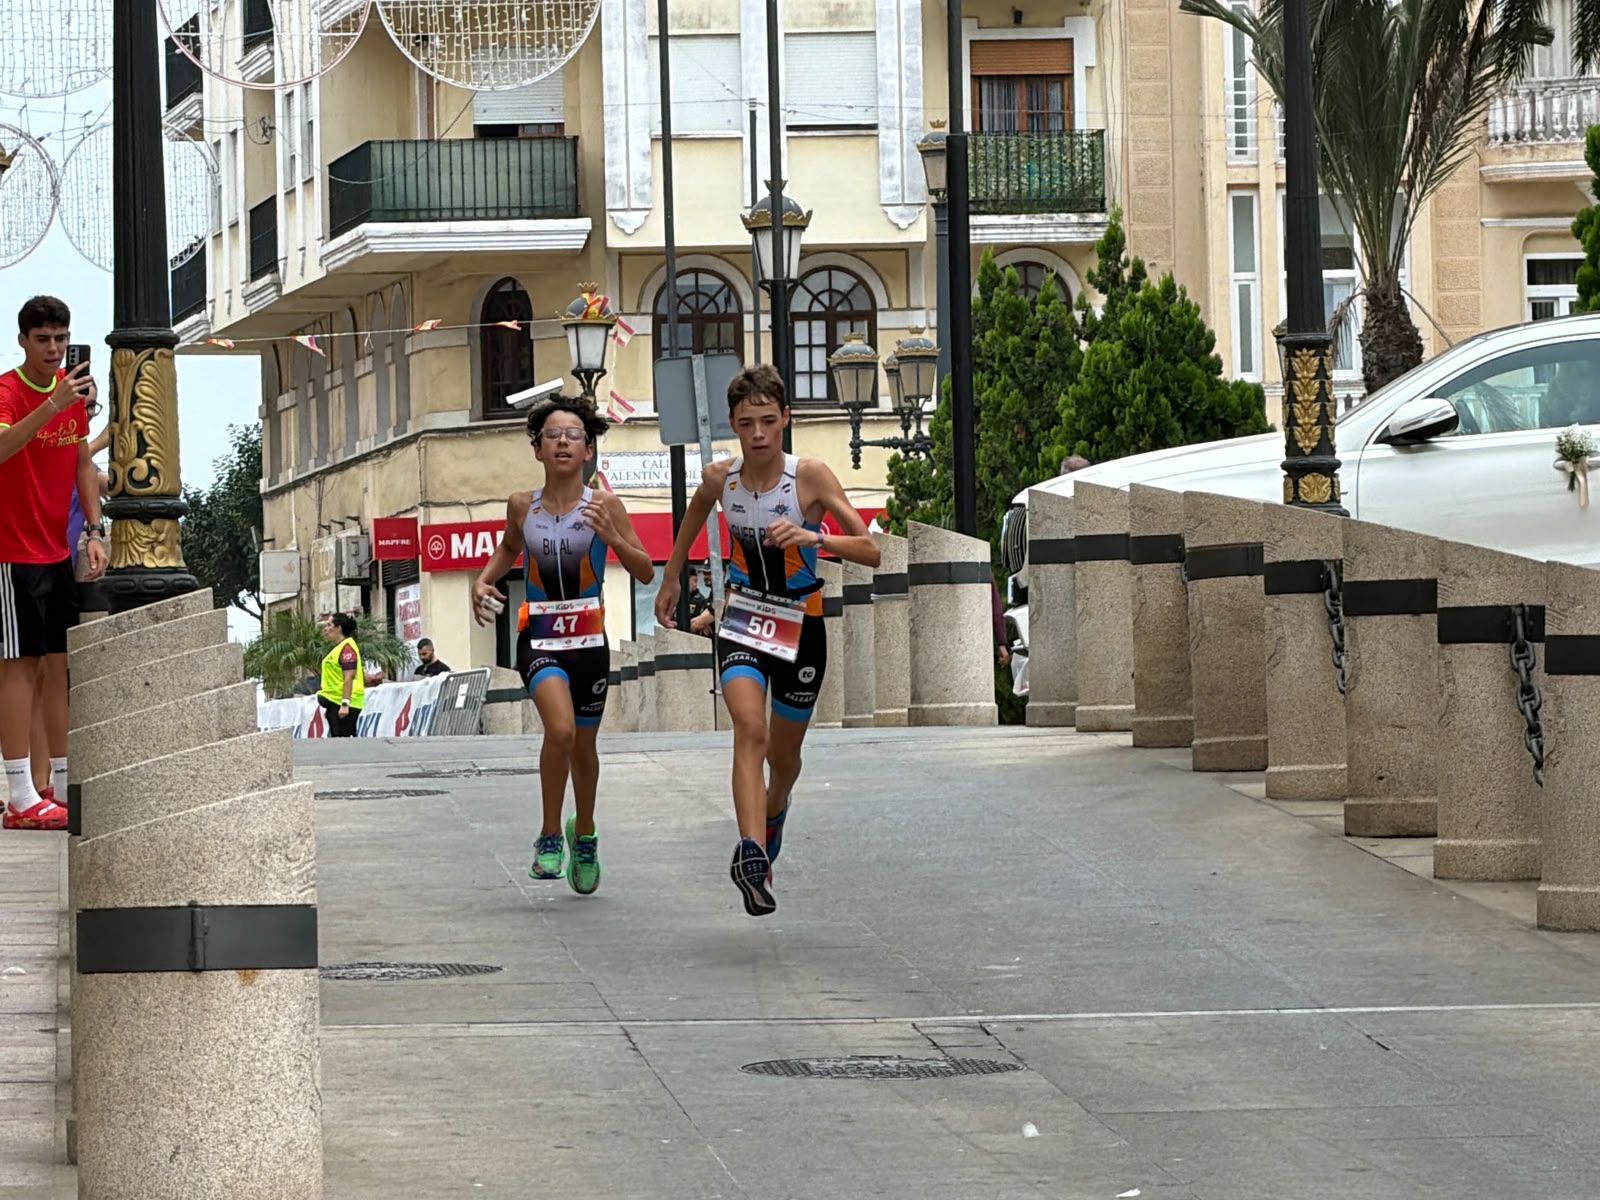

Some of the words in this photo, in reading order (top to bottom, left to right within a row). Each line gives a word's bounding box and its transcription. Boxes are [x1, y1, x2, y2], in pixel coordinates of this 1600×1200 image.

[543, 538, 572, 555] BILAL
[552, 614, 578, 634] 47
[747, 615, 777, 640] 50
